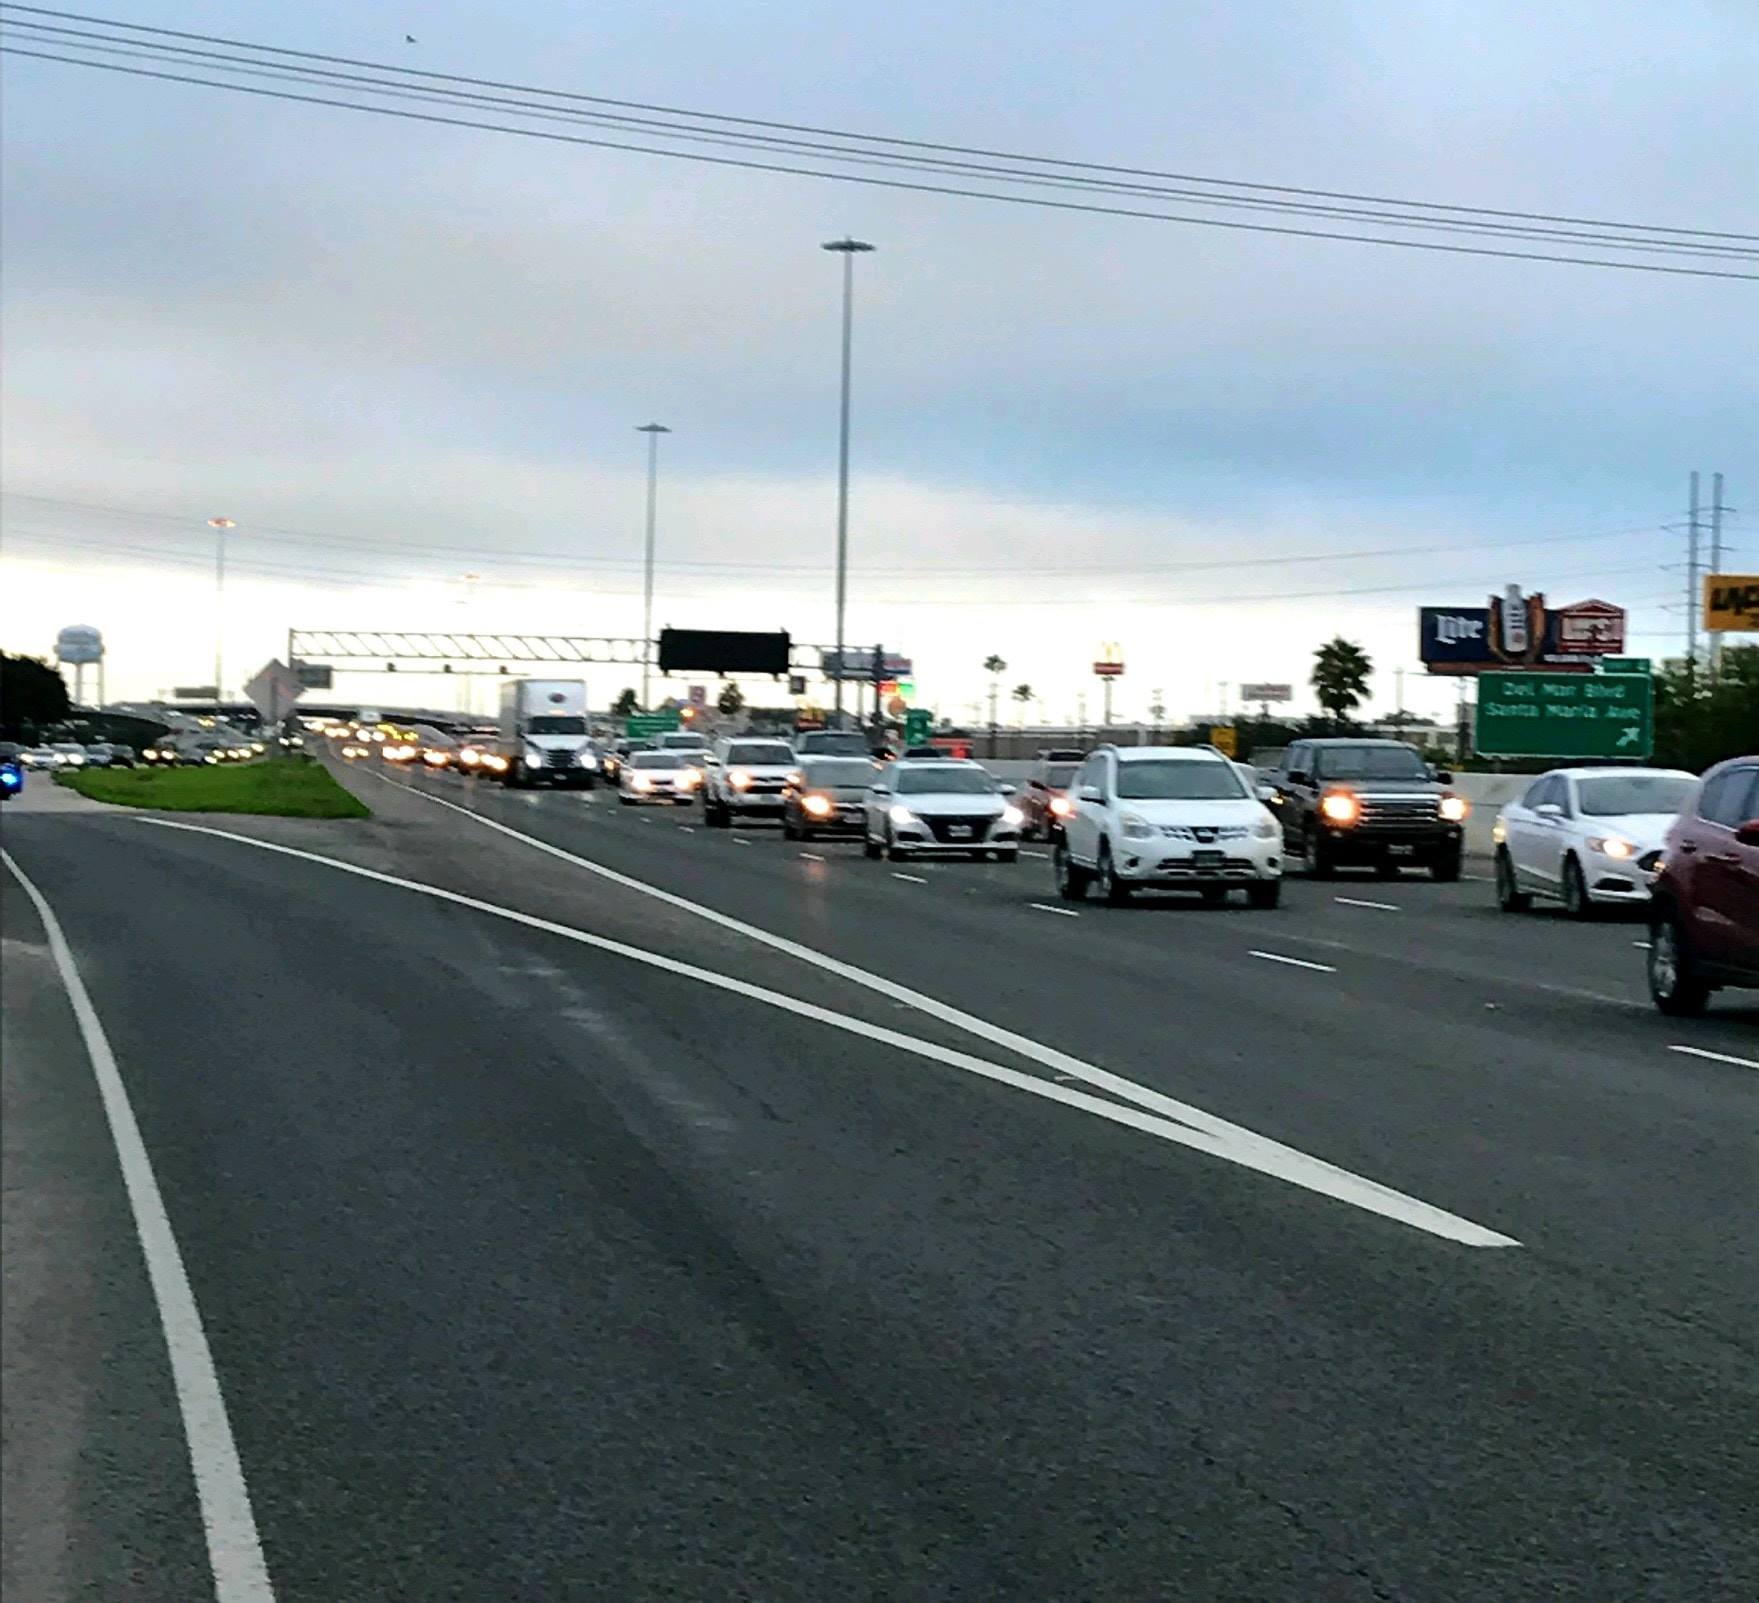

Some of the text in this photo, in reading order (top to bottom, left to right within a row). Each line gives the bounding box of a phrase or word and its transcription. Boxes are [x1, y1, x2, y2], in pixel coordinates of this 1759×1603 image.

[1502, 681, 1626, 699] Del Mar Blvd
[1484, 702, 1641, 720] Santa Maria Ave
